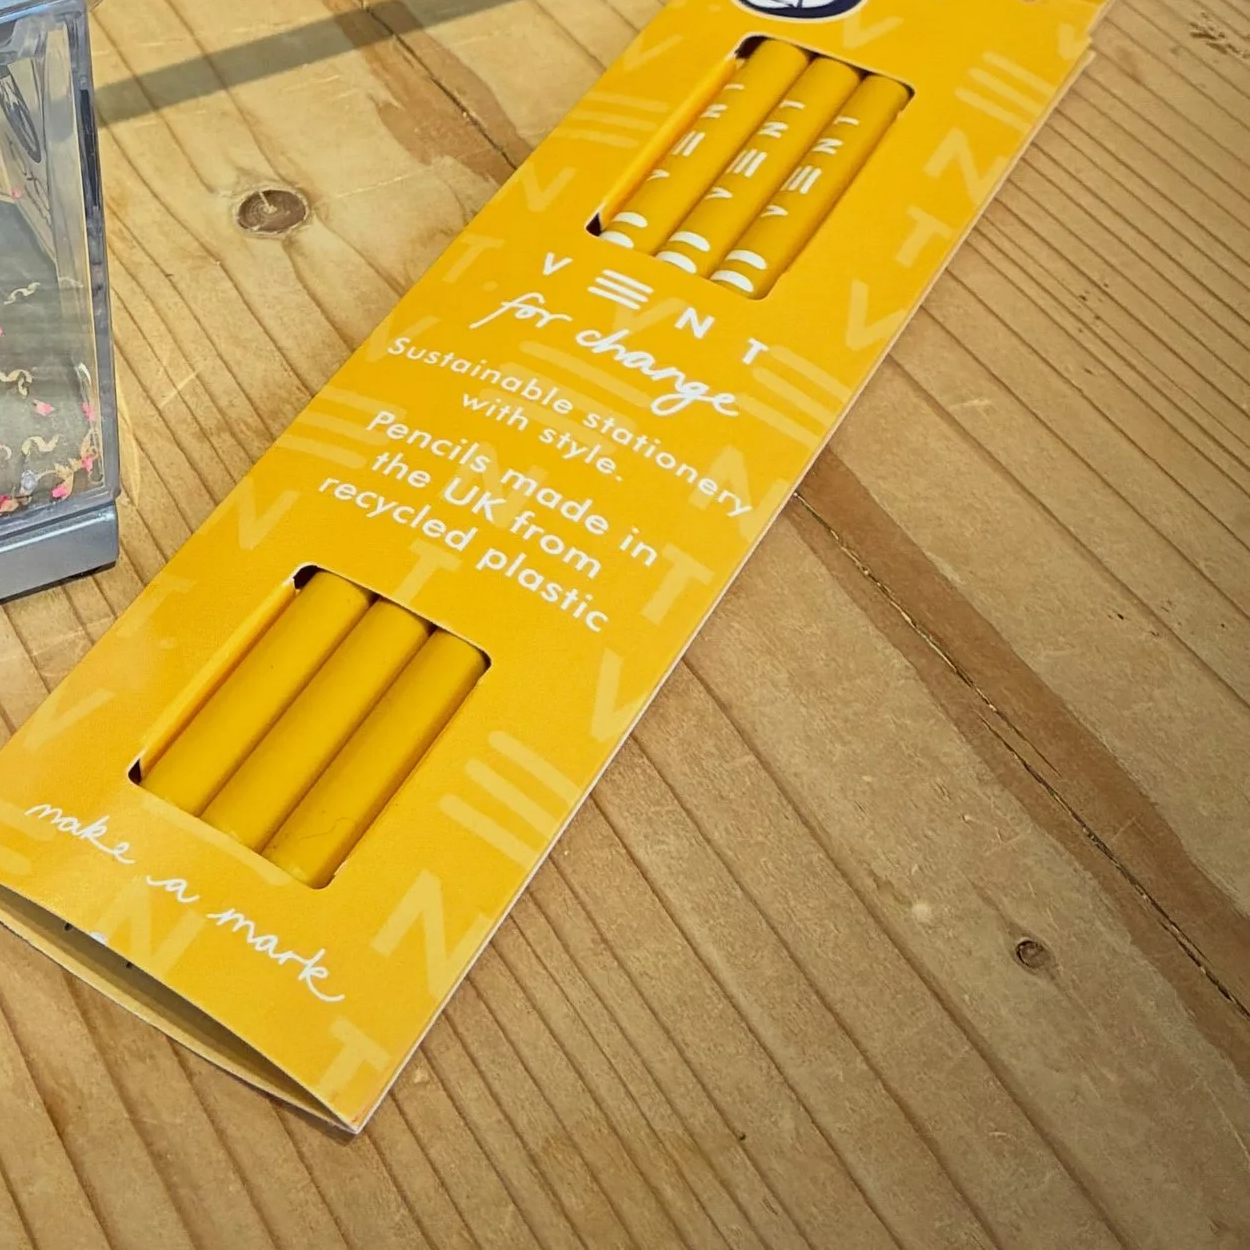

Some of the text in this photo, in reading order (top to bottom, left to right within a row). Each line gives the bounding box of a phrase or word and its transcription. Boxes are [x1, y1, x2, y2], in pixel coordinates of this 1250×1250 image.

[387, 336, 753, 519] Sustainable stationery
[469, 291, 740, 418] for change
[365, 409, 658, 568] Pencils made in
[371, 451, 602, 580] the UK from
[462, 391, 626, 484] with style.
[318, 477, 610, 634] recycled plastic
[24, 802, 347, 1004] make a mark
